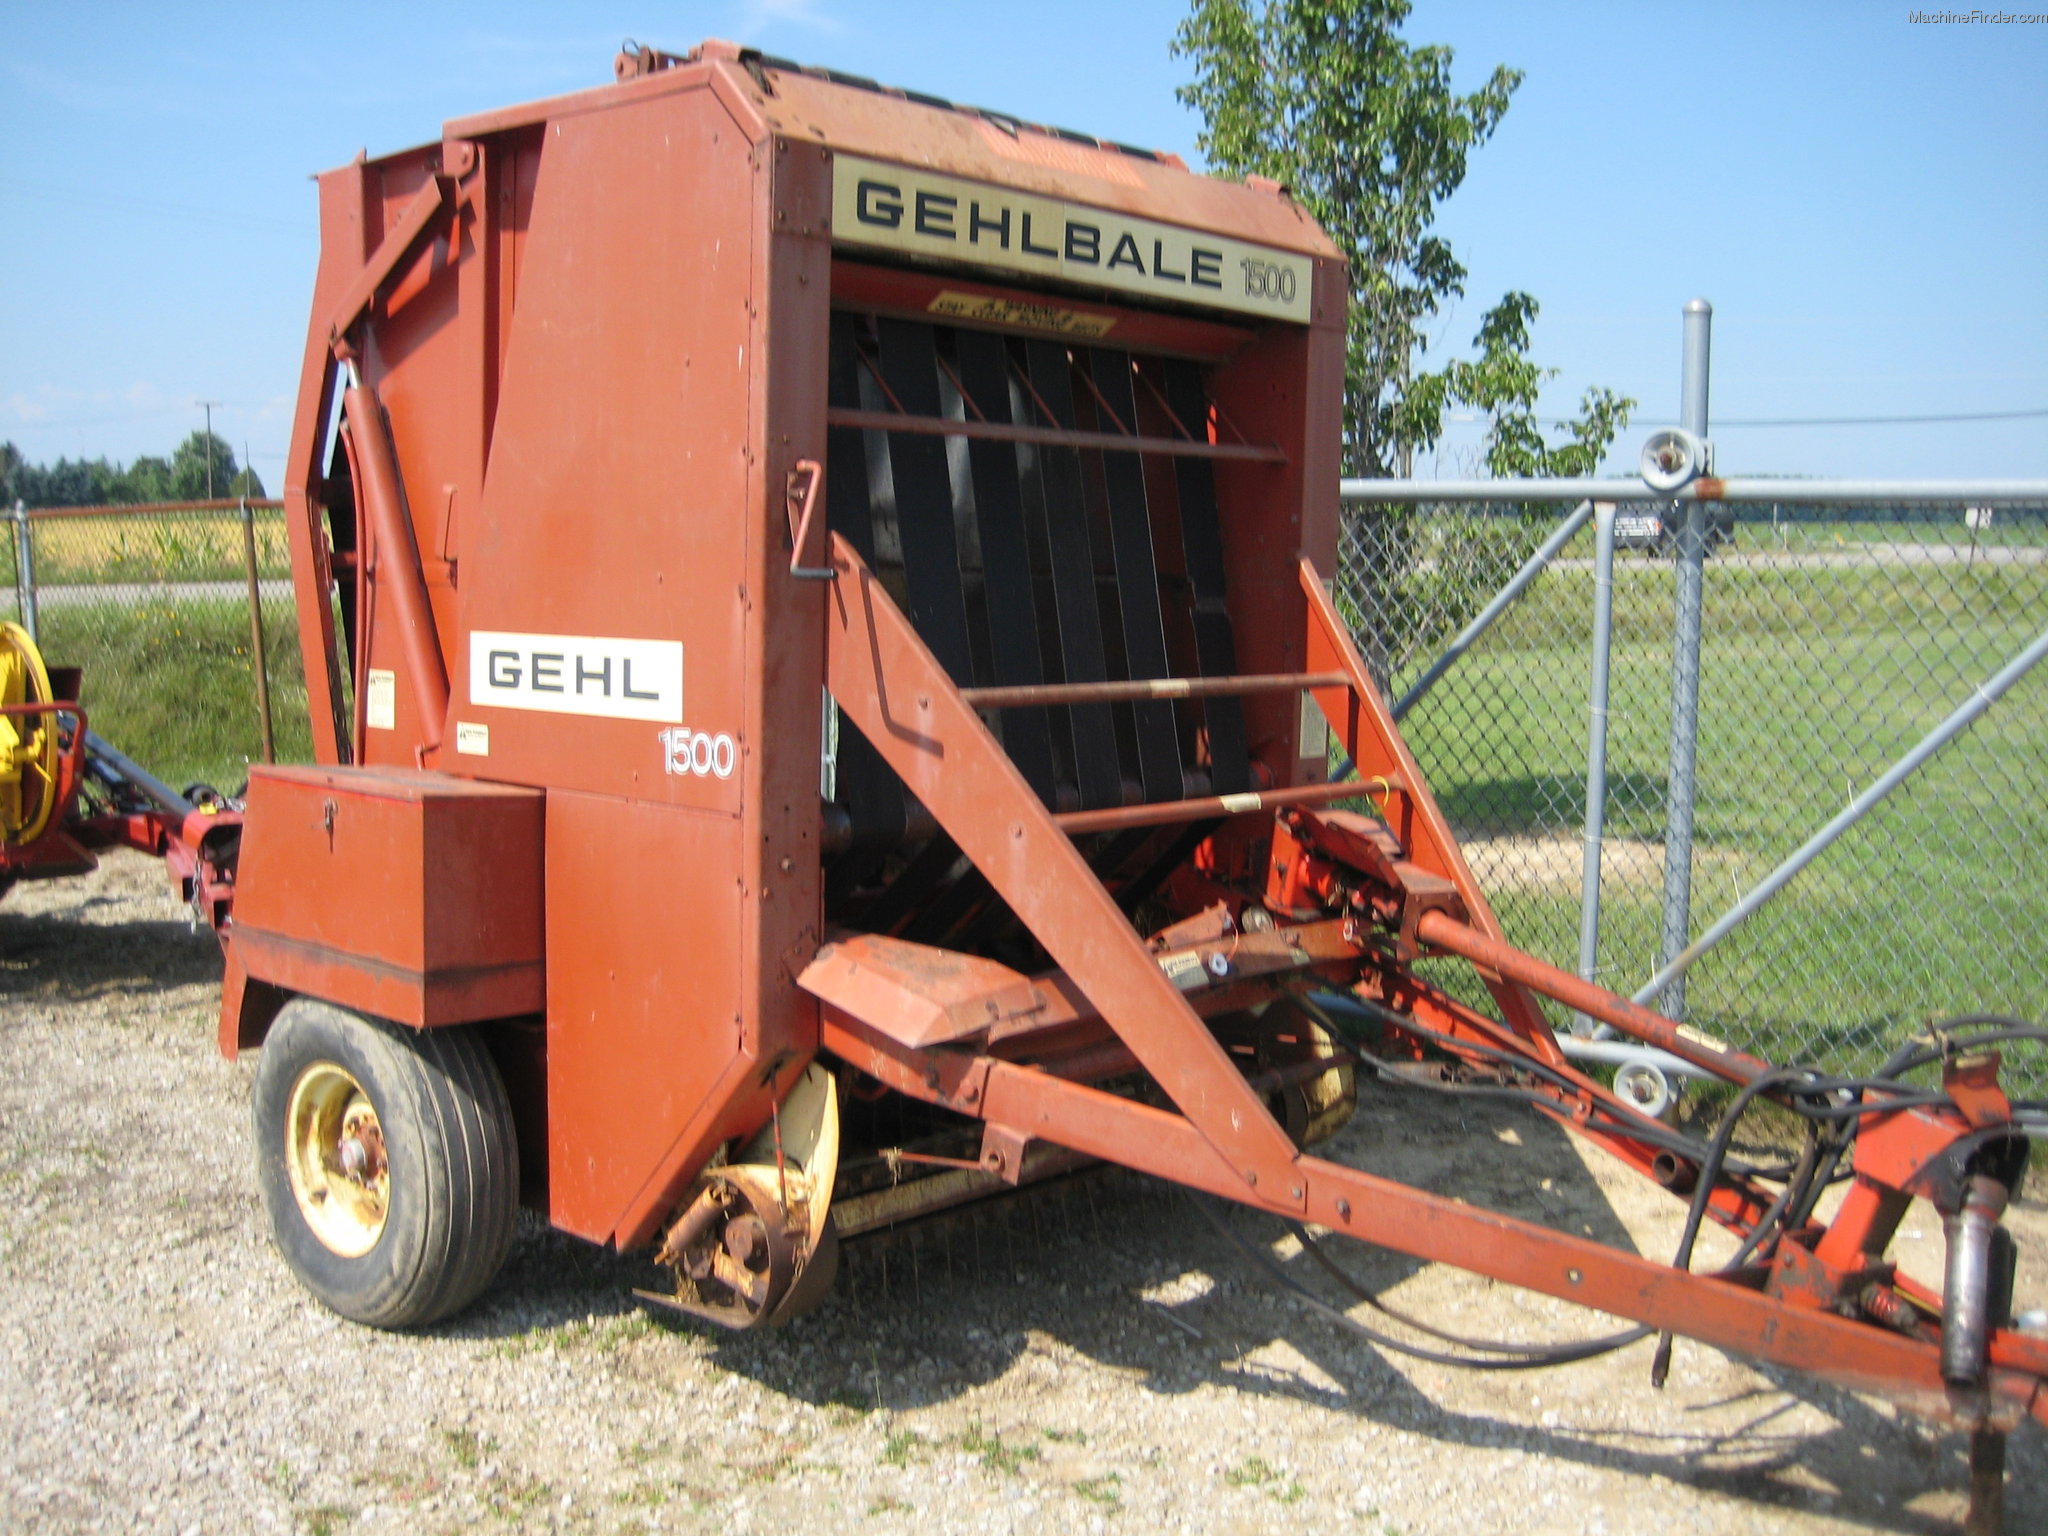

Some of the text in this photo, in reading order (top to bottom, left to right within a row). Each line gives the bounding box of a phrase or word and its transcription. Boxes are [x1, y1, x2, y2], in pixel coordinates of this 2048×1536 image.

[856, 179, 1297, 304] GEHLBALE 1500
[489, 651, 659, 700] GEHL
[659, 727, 735, 778] 1500
